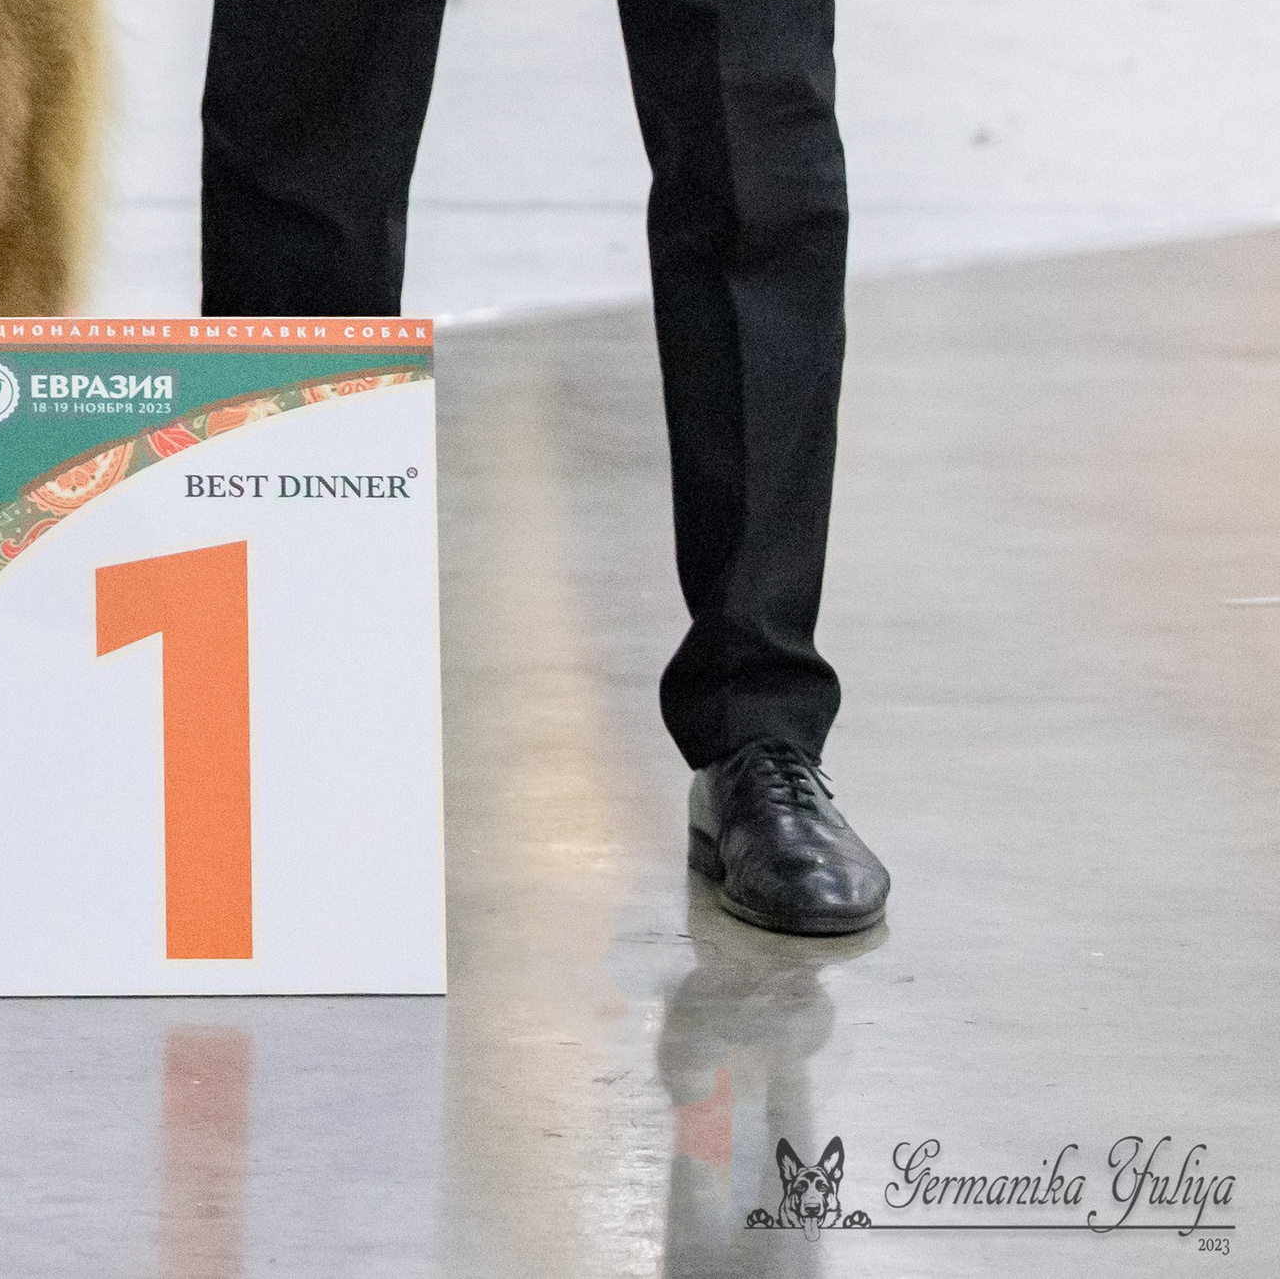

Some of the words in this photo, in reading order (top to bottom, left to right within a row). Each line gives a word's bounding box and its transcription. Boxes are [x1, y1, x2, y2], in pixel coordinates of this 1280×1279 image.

[189, 325, 326, 338] ВЫСТАВКИ
[344, 326, 426, 338] СОБАК
[31, 375, 172, 399] ЕВРАЗИЯ
[32, 402, 68, 413] 18-19
[74, 402, 133, 413] НОЯБРЯ
[138, 402, 172, 414] 2023
[185, 474, 268, 498] BEST
[95, 540, 253, 959] 1
